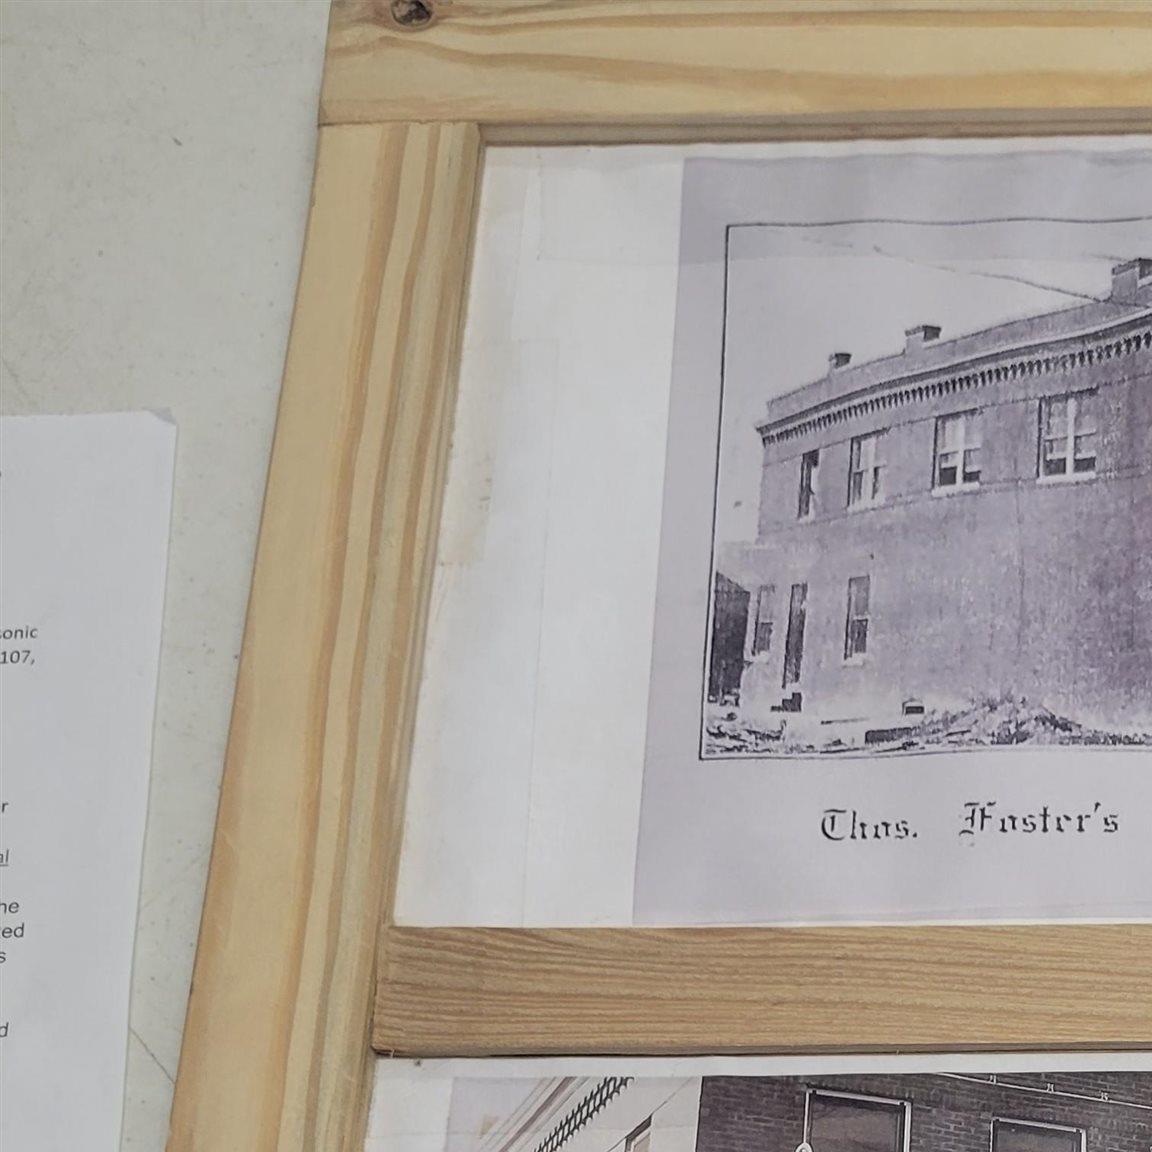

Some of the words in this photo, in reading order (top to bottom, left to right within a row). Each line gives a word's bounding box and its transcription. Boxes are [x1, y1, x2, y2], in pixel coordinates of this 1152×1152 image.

[0, 625, 39, 640] onic
[820, 808, 919, 842] Thos.
[958, 800, 1119, 838] Foster's
